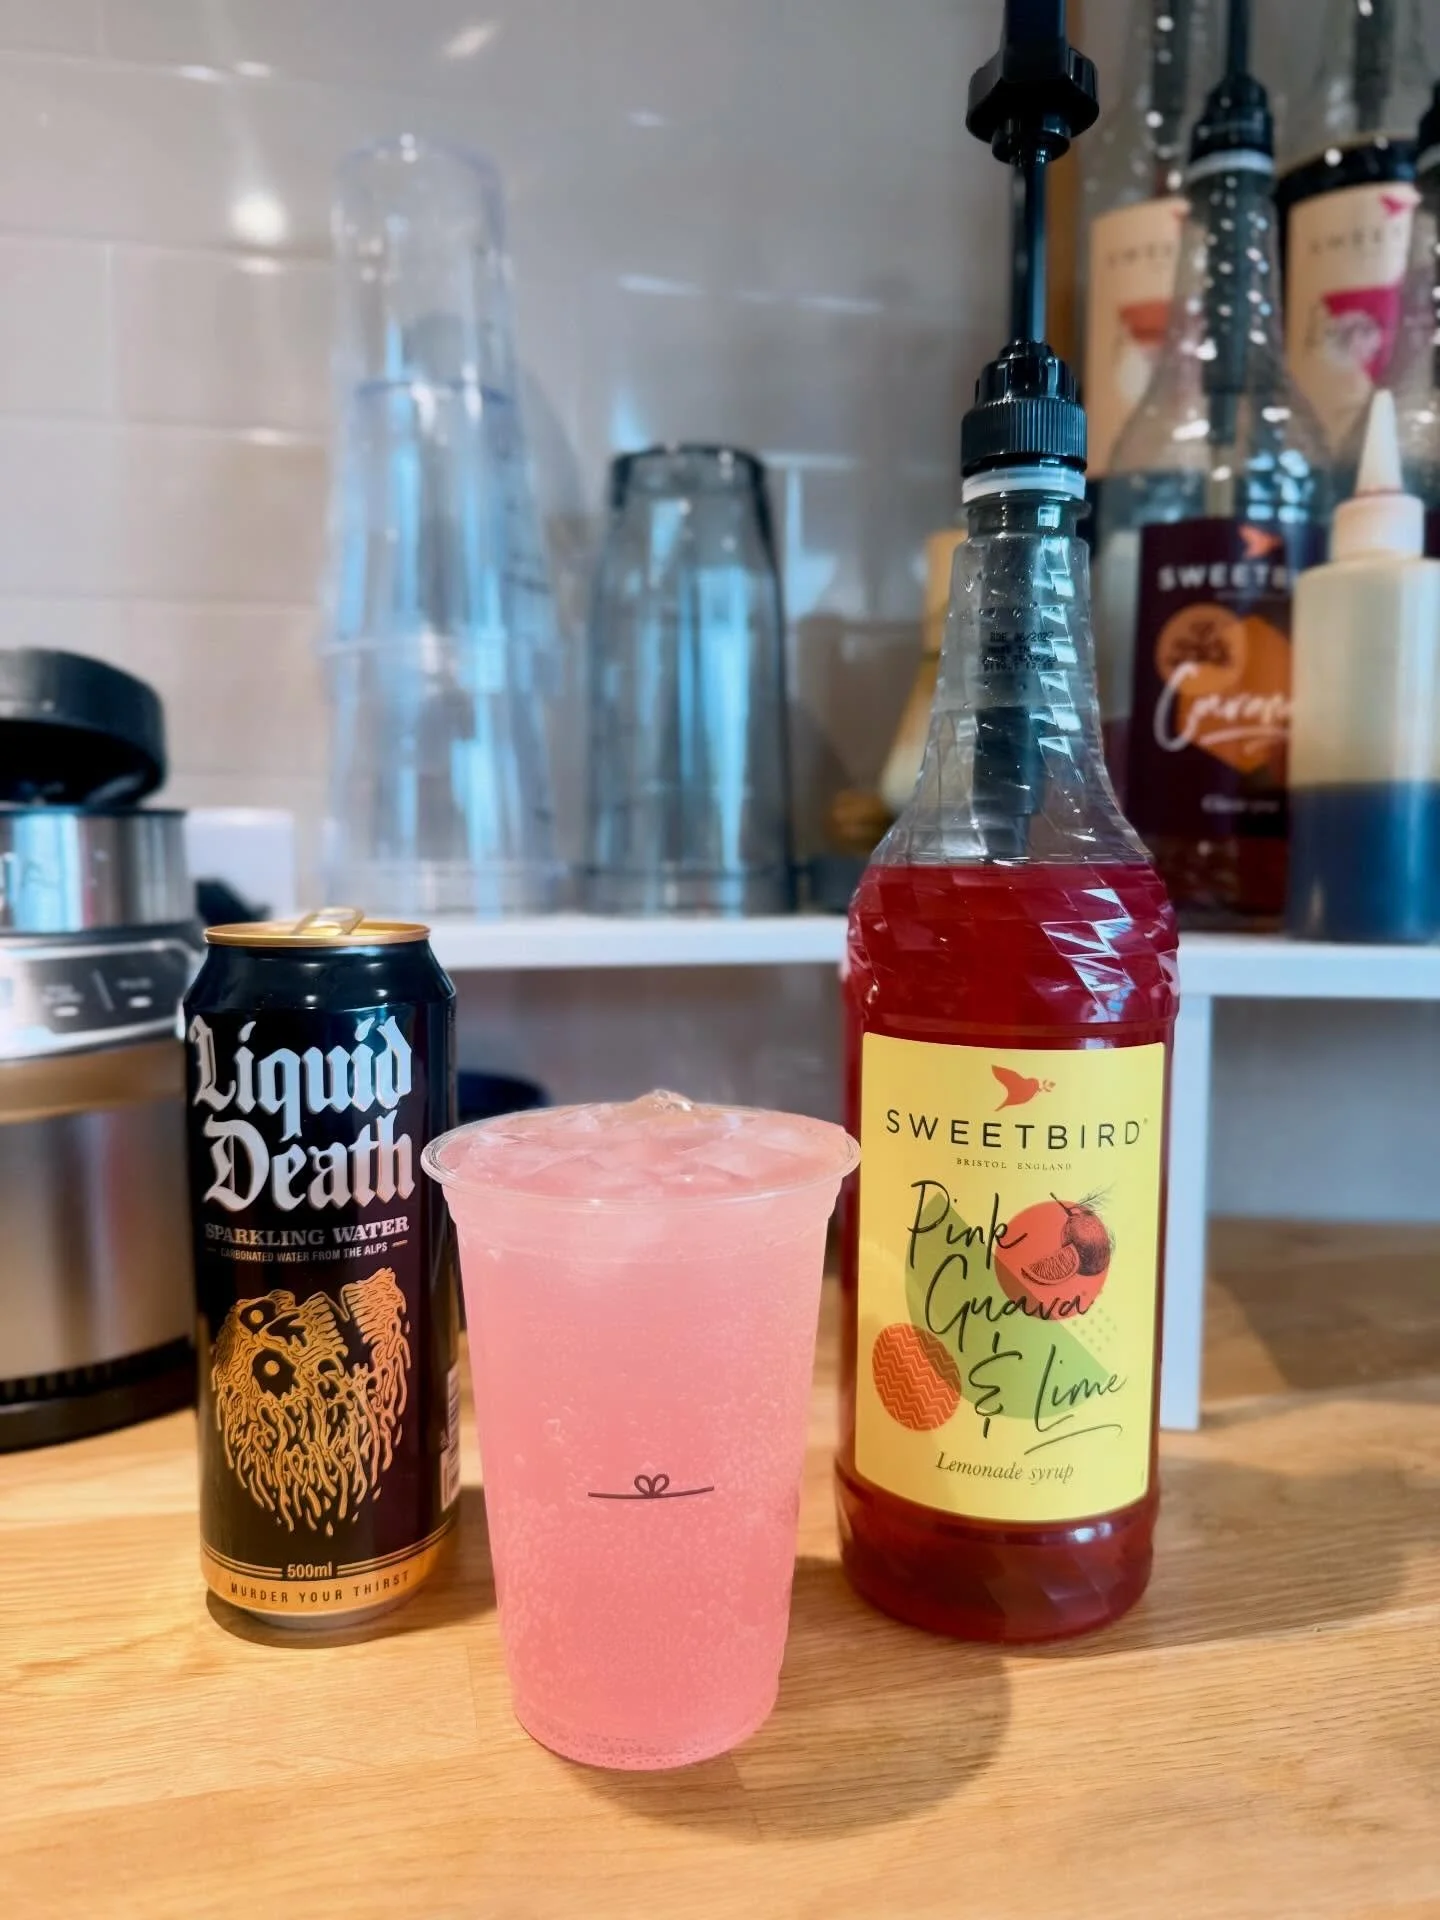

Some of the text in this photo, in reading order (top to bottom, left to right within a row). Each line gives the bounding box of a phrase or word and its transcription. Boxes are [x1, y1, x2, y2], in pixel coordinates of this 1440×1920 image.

[188, 1015, 412, 1142] Liquid
[886, 1109, 1140, 1150] SWEETBIRD
[202, 1110, 416, 1212] Death
[956, 1157, 1072, 1172] BRISTOL ENGLAND
[204, 1215, 410, 1246] SPARKLING WATER
[907, 1180, 1028, 1270] Pink
[220, 1240, 388, 1263] CARBONATED WATER FROM THE ALPS
[924, 1253, 1092, 1353] Guava
[968, 1331, 1129, 1439] & Lime
[935, 1451, 1075, 1486] Lemonade syrup
[230, 1570, 410, 1603] MURDER YOUR THIRST
[286, 1561, 333, 1578] 500ml
